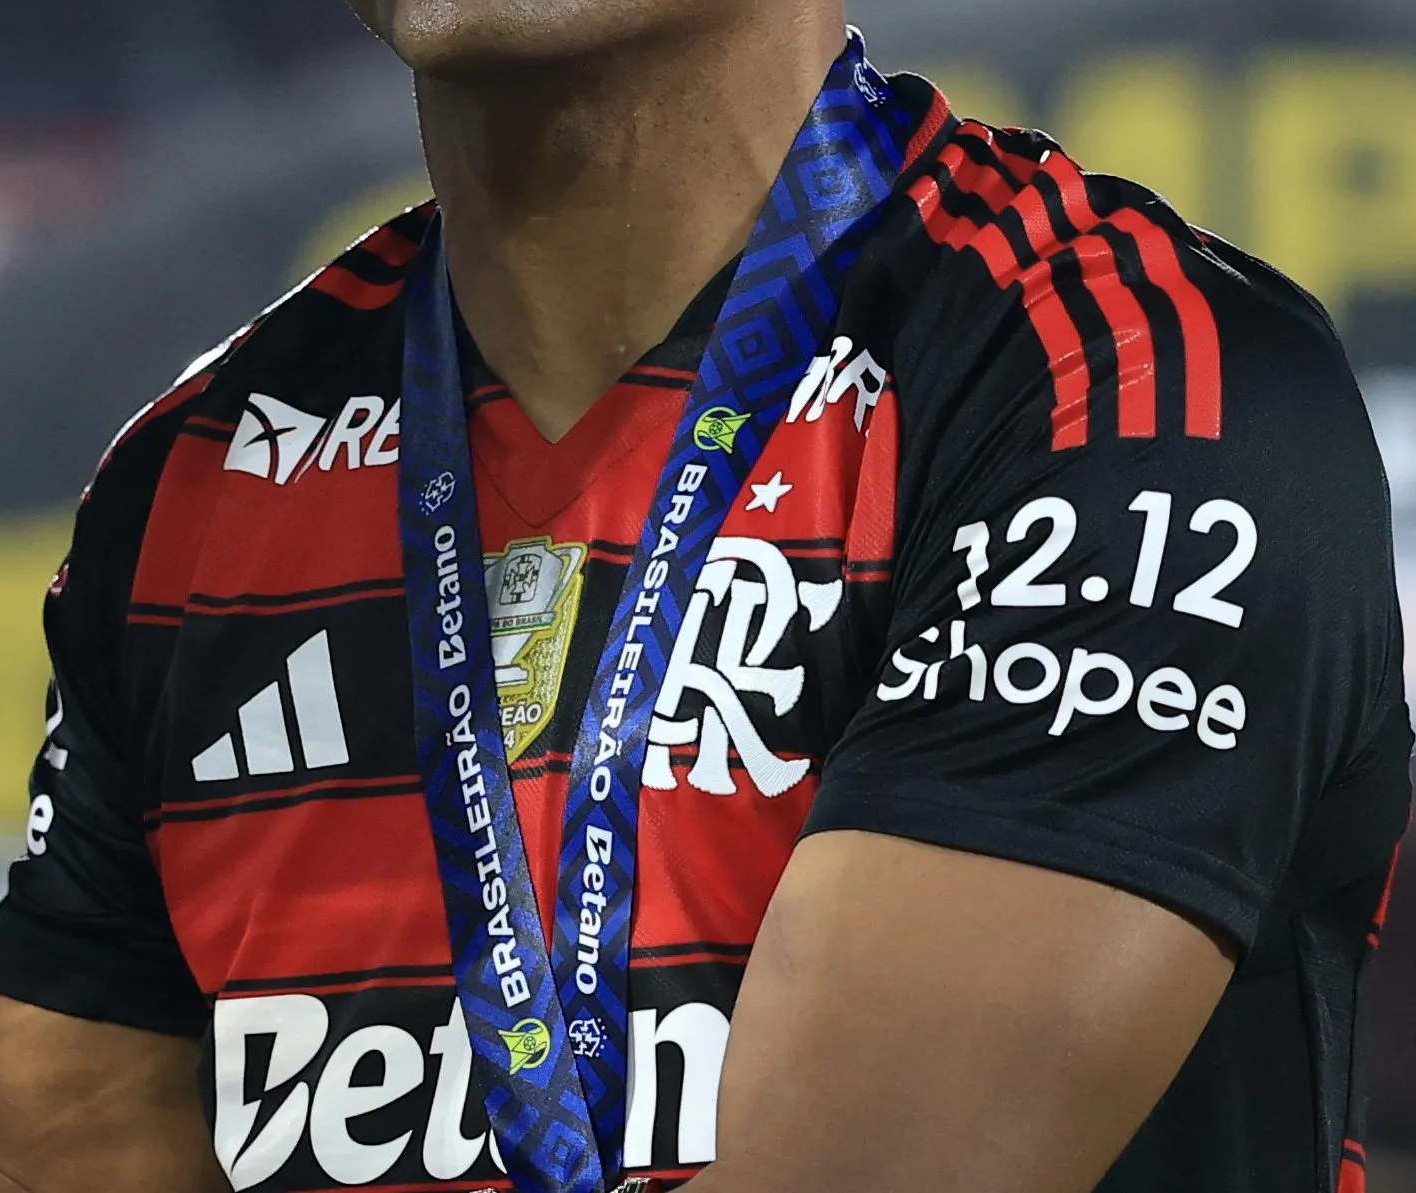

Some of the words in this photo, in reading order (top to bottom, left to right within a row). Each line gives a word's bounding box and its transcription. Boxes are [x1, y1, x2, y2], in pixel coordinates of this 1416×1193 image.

[434, 524, 466, 670] Betano
[589, 463, 708, 802] BRASILEIRÃO
[953, 490, 1259, 631] 12.12
[876, 620, 1248, 750] Shopee
[445, 684, 532, 1008] BRASILEIRÃO
[574, 822, 613, 997] Betano
